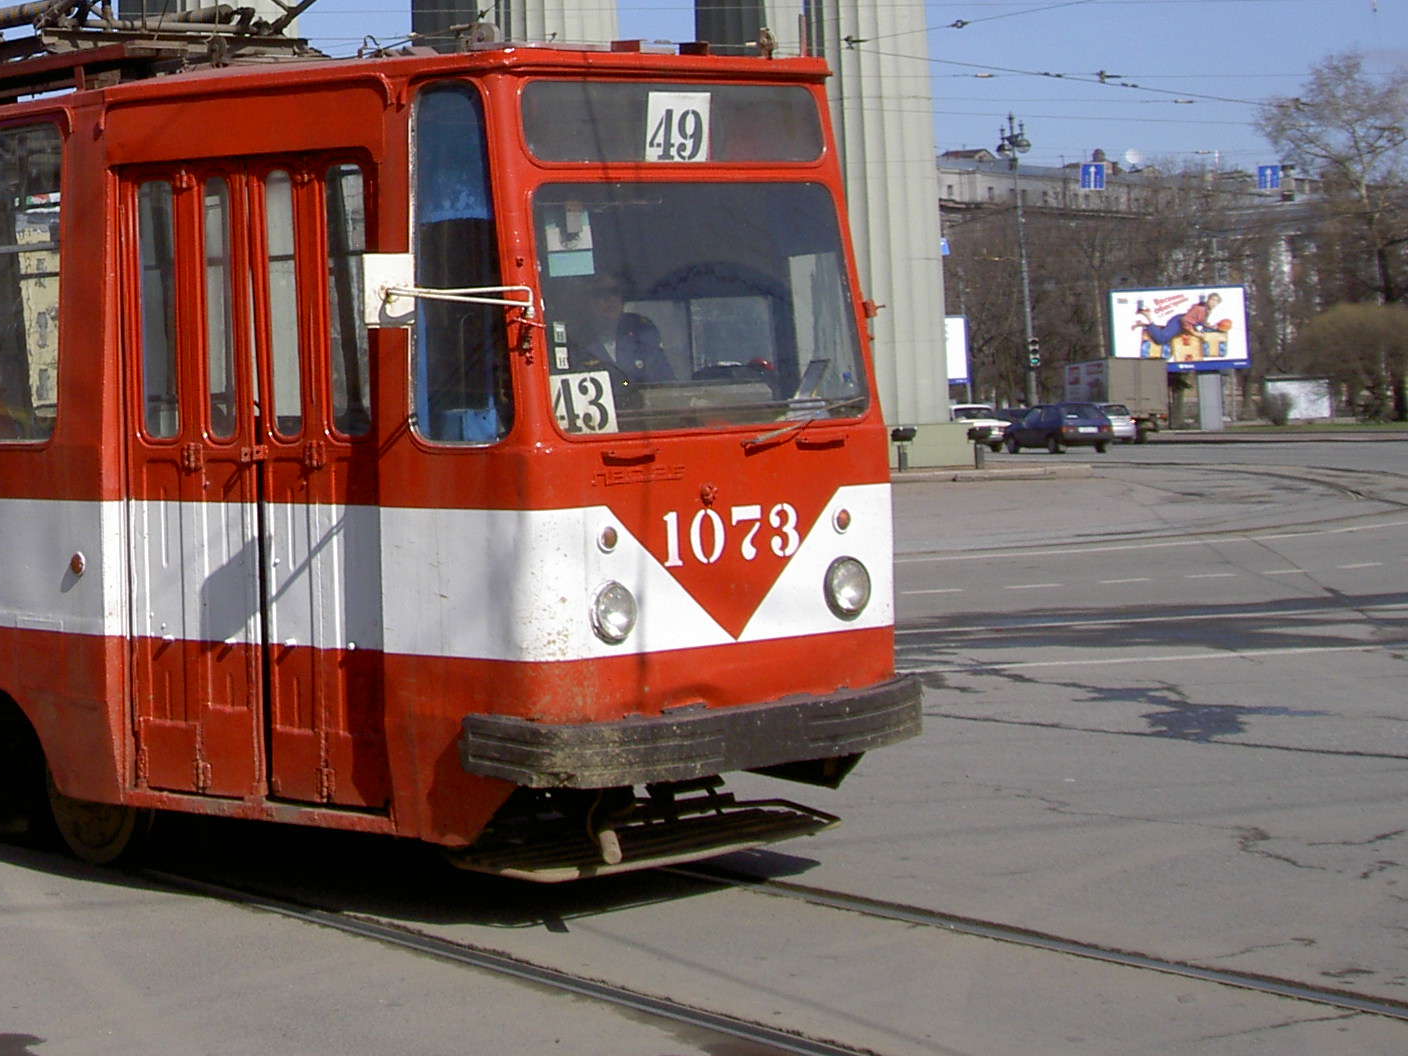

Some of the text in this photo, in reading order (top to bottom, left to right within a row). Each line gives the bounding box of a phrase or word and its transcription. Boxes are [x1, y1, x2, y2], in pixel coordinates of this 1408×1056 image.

[648, 108, 704, 161] 49
[553, 376, 609, 432] 43
[662, 502, 801, 567] 1073
